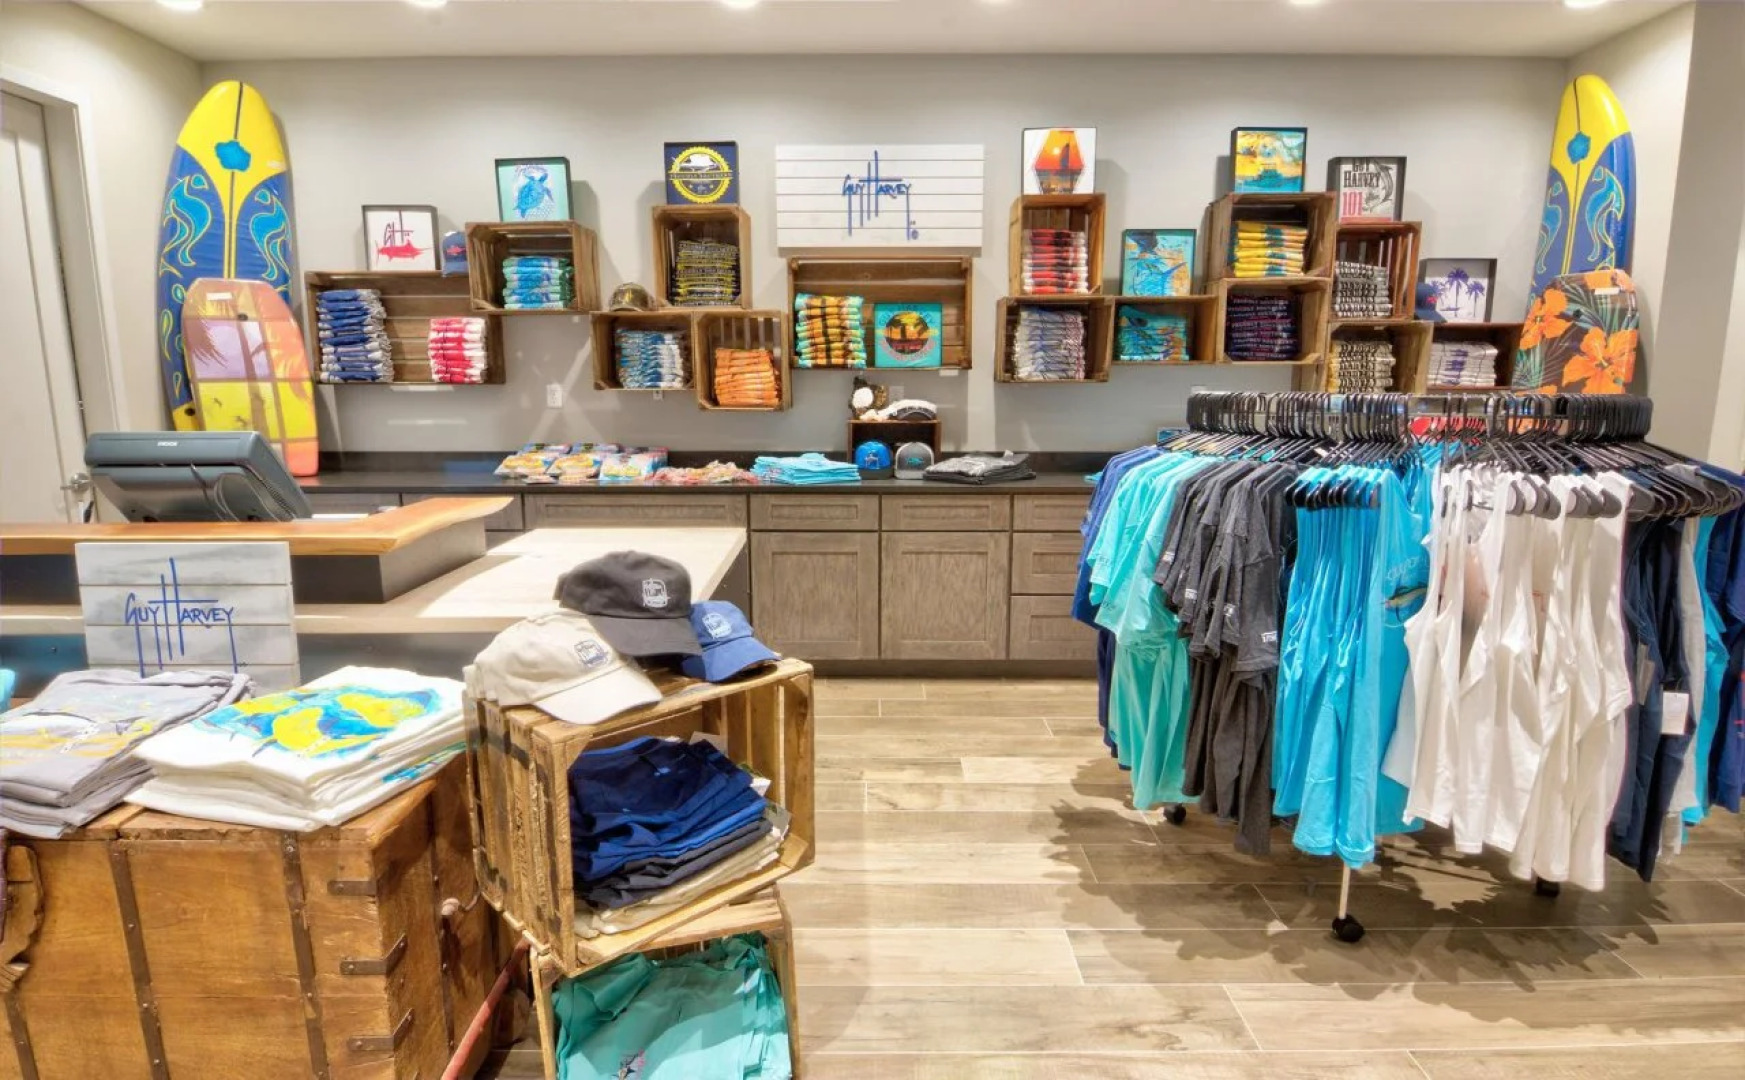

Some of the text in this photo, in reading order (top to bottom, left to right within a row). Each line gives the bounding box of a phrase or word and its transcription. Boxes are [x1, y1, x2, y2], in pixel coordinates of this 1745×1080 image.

[843, 150, 912, 240] GUY HARVEY
[1343, 191, 1363, 216] 101
[1344, 171, 1381, 188] HARVEY
[125, 557, 236, 679] GUY HARVEY
